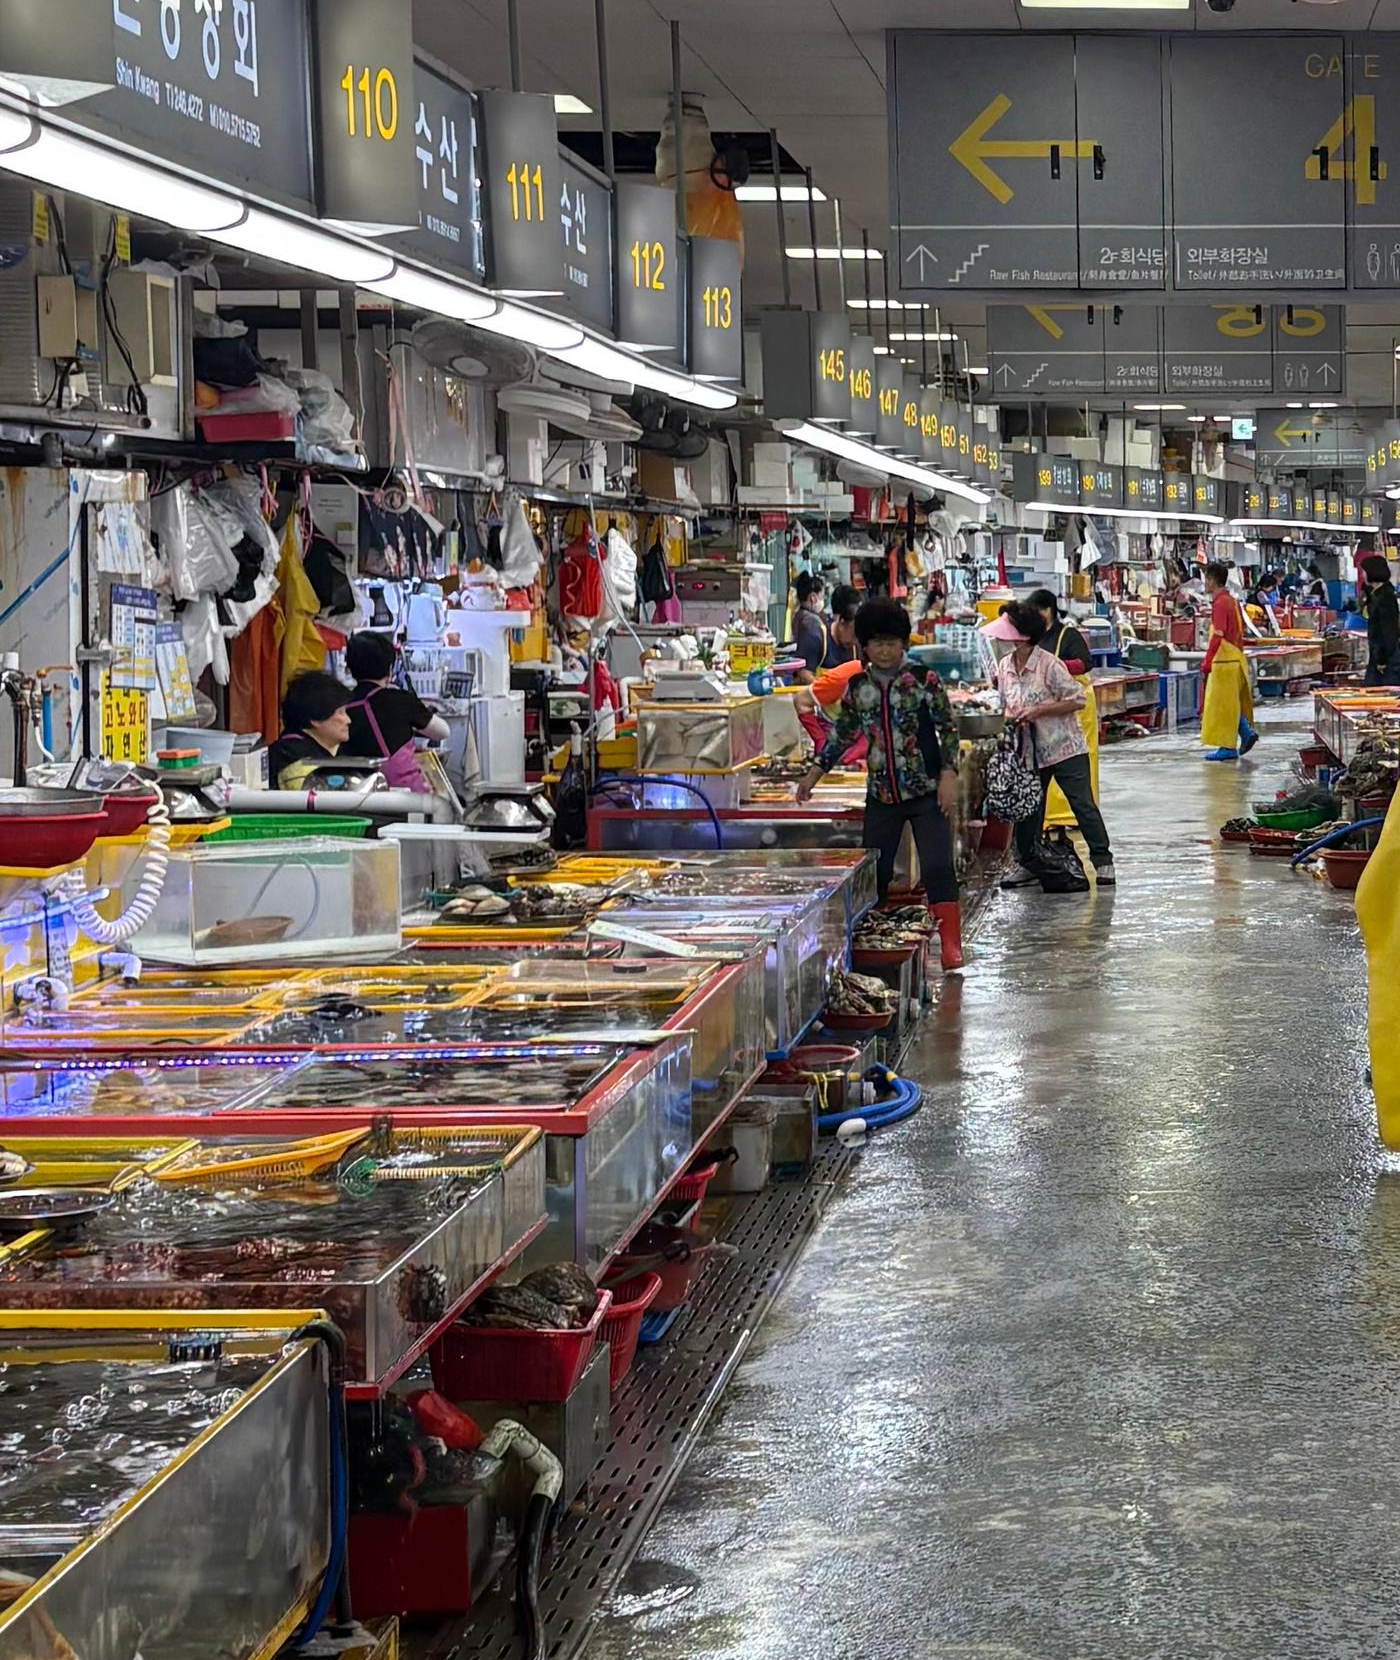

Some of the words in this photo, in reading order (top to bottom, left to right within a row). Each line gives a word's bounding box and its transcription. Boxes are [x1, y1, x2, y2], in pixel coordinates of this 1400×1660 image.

[341, 64, 398, 141] 110
[1304, 94, 1388, 205] 4
[507, 162, 544, 222] 111
[631, 241, 665, 291] 112
[1187, 247, 1268, 265] 외부화장실
[1012, 269, 1030, 281] Fish
[702, 286, 732, 330] 113
[819, 349, 845, 382] 145
[849, 369, 872, 399] 146
[878, 390, 899, 417] 147
[902, 401, 917, 428] 48
[919, 412, 938, 437] 149
[939, 424, 957, 448] 150
[958, 433, 969, 454] 51
[972, 444, 987, 463] 152
[1377, 448, 1386, 466] 15
[988, 451, 998, 472] 53
